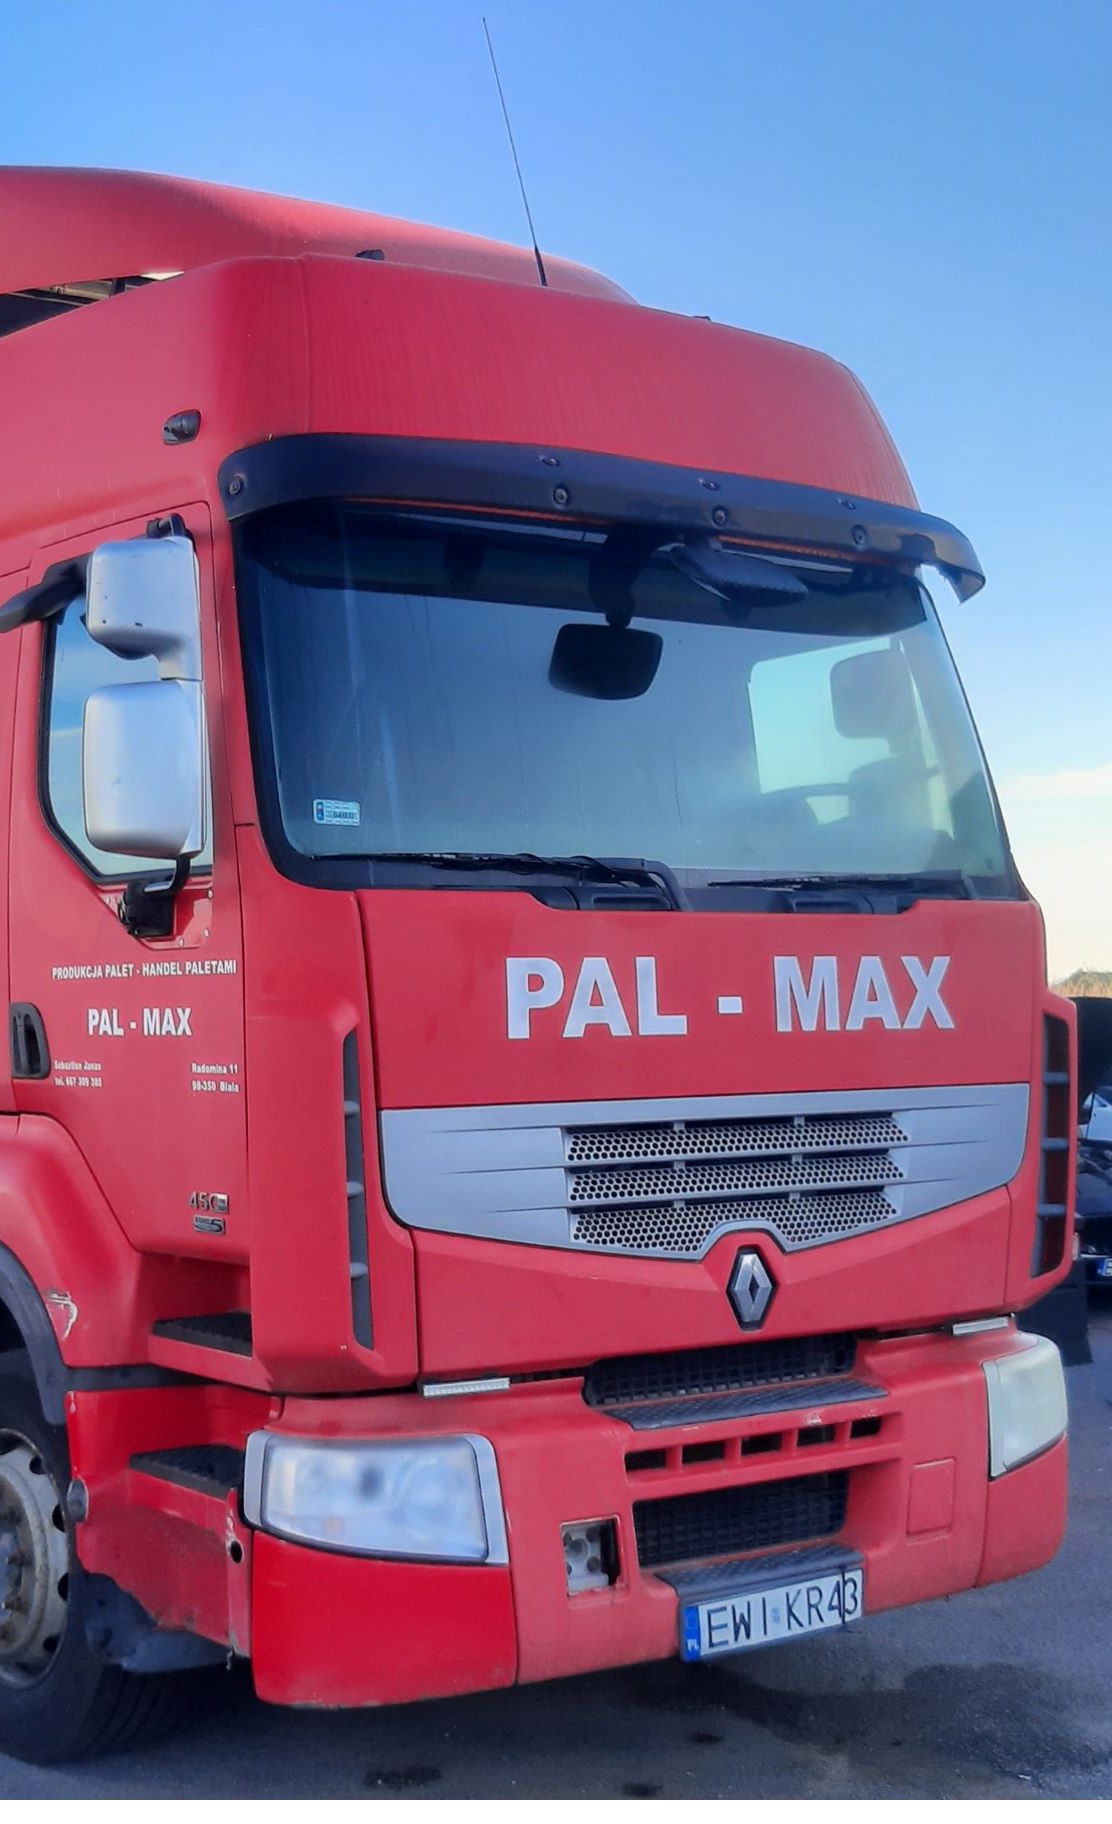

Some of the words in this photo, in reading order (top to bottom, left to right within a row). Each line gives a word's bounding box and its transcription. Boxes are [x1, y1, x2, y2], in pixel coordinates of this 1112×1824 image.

[52, 964, 103, 980] PRODUKCJA
[105, 963, 134, 978] PALET
[142, 962, 183, 977] HANDEL
[185, 960, 237, 975] PALETAMI
[505, 956, 688, 1040] PAL
[717, 995, 743, 1014] -
[773, 955, 956, 1032] MAX
[88, 1008, 124, 1036] PAL
[143, 1007, 192, 1036] MAX
[229, 1063, 238, 1074] 11
[706, 1597, 768, 1650] EWI
[687, 1638, 699, 1651] PL
